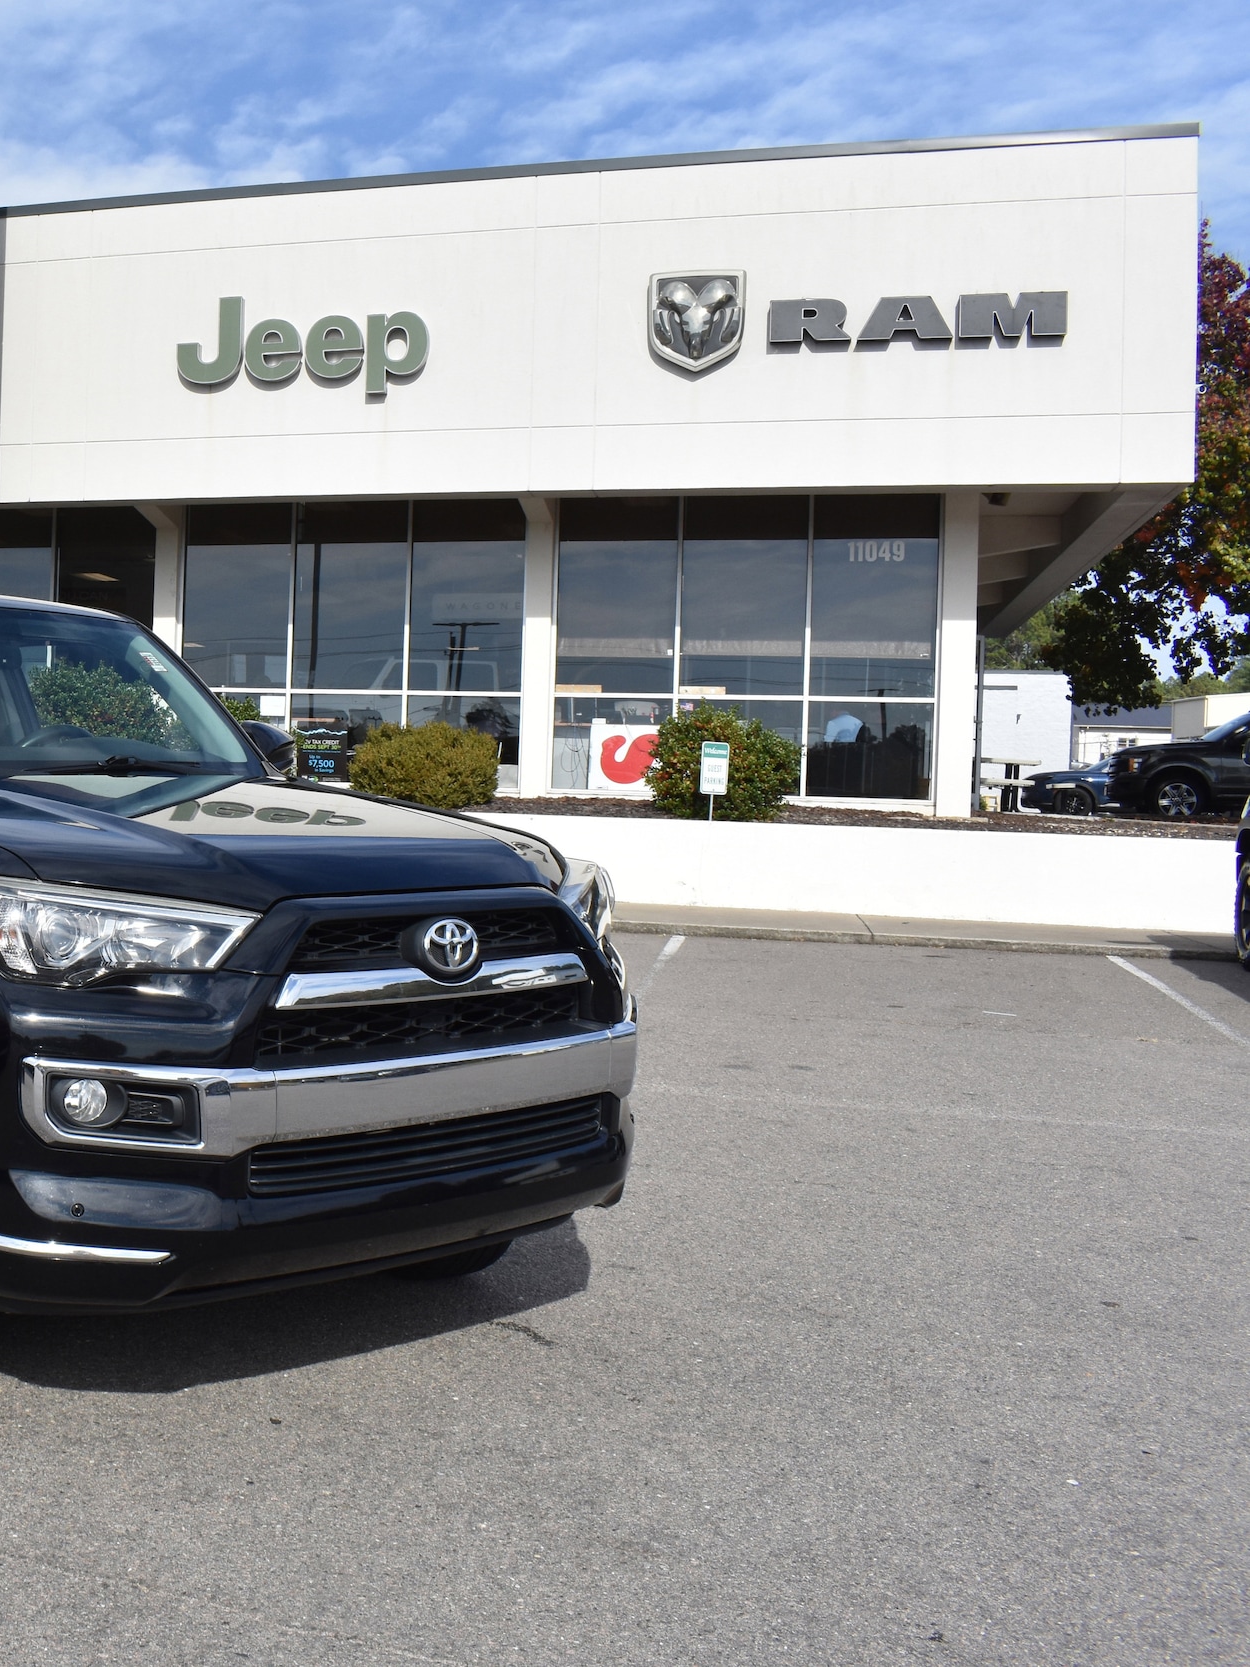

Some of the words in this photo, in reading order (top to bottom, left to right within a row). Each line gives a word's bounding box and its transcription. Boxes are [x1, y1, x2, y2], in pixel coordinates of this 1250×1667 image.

[768, 290, 1069, 344] RAM
[176, 296, 430, 395] Jeep
[847, 541, 905, 562] 11049
[308, 760, 335, 769] $7,500
[707, 764, 723, 772] GUEST
[704, 776, 725, 785] PARKING
